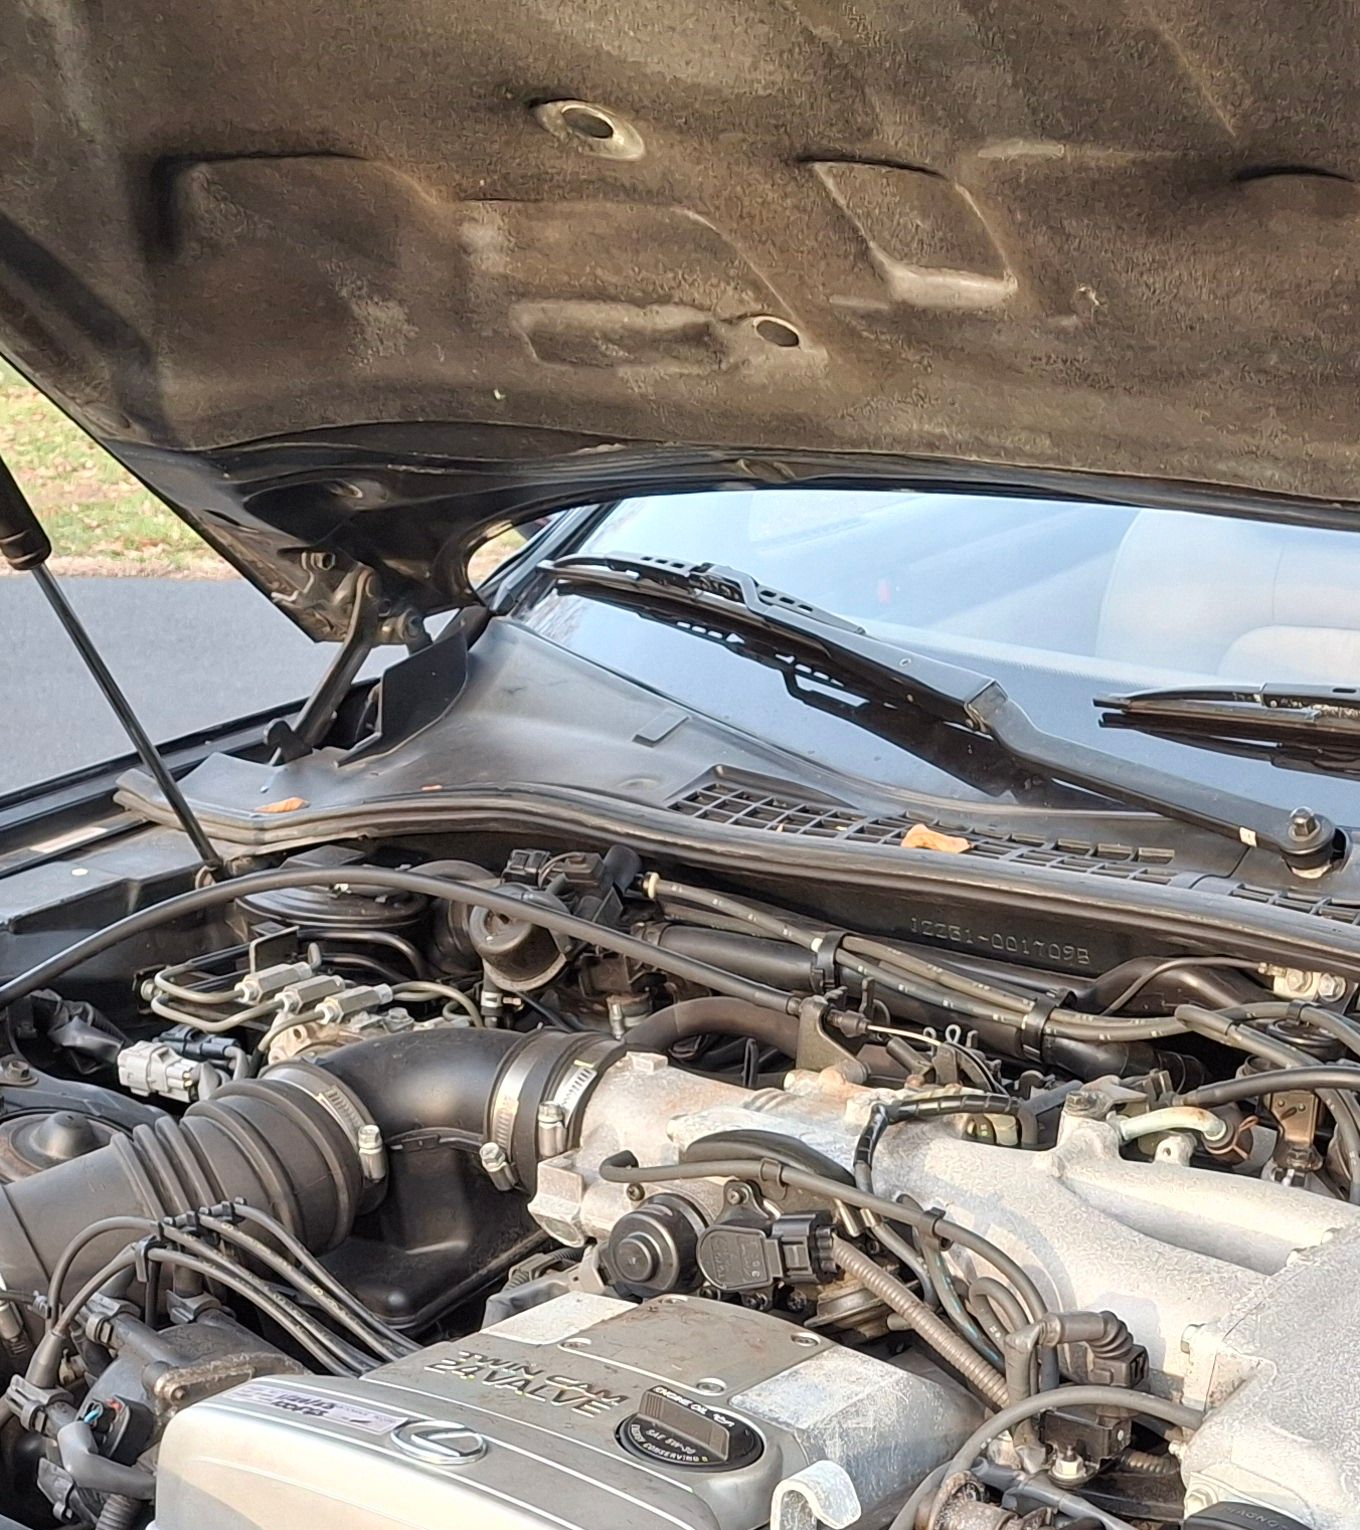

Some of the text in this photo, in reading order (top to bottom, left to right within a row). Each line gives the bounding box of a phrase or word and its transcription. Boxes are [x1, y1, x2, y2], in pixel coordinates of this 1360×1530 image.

[459, 1351, 629, 1406] TWIN CAM
[654, 1386, 708, 1415] ENGINE OIL
[643, 1442, 699, 1463] CONSERVING
